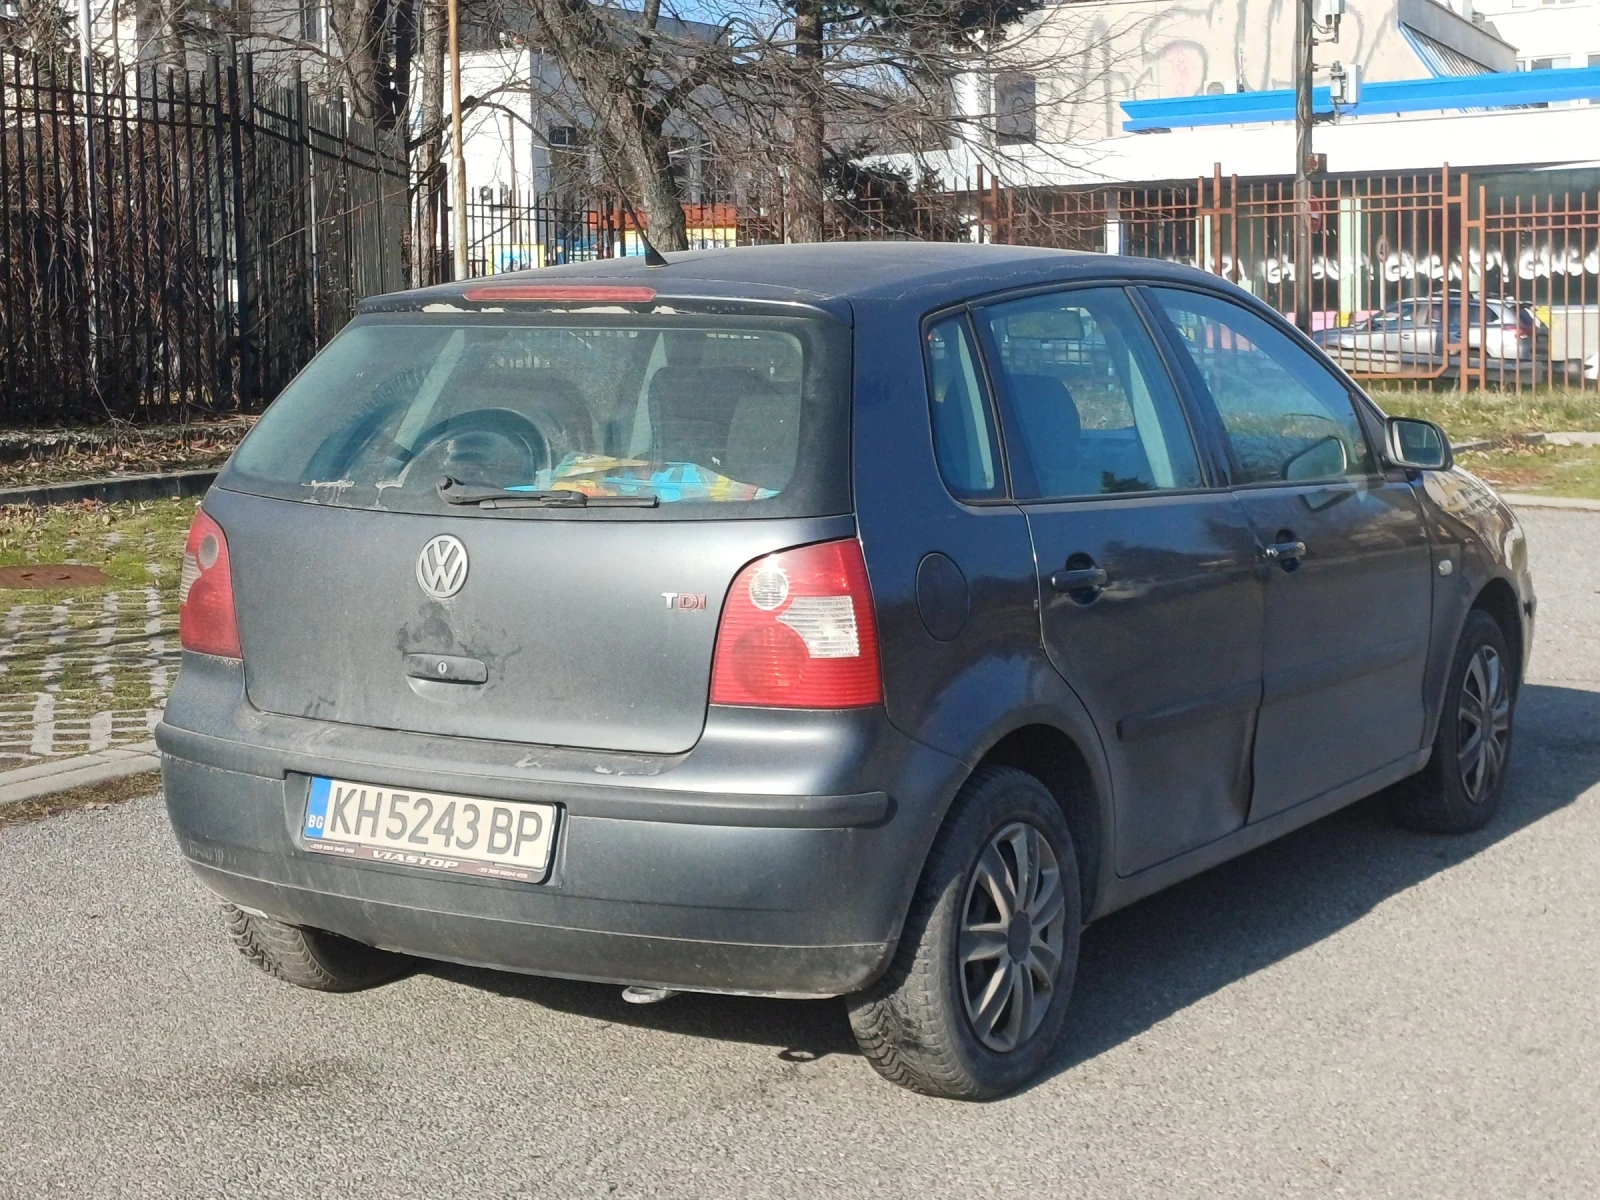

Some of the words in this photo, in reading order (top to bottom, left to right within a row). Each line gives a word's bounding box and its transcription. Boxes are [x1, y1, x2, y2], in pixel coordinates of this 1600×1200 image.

[661, 592, 706, 611] TDI
[307, 814, 324, 830] BG
[371, 849, 460, 870] VIASTOP
